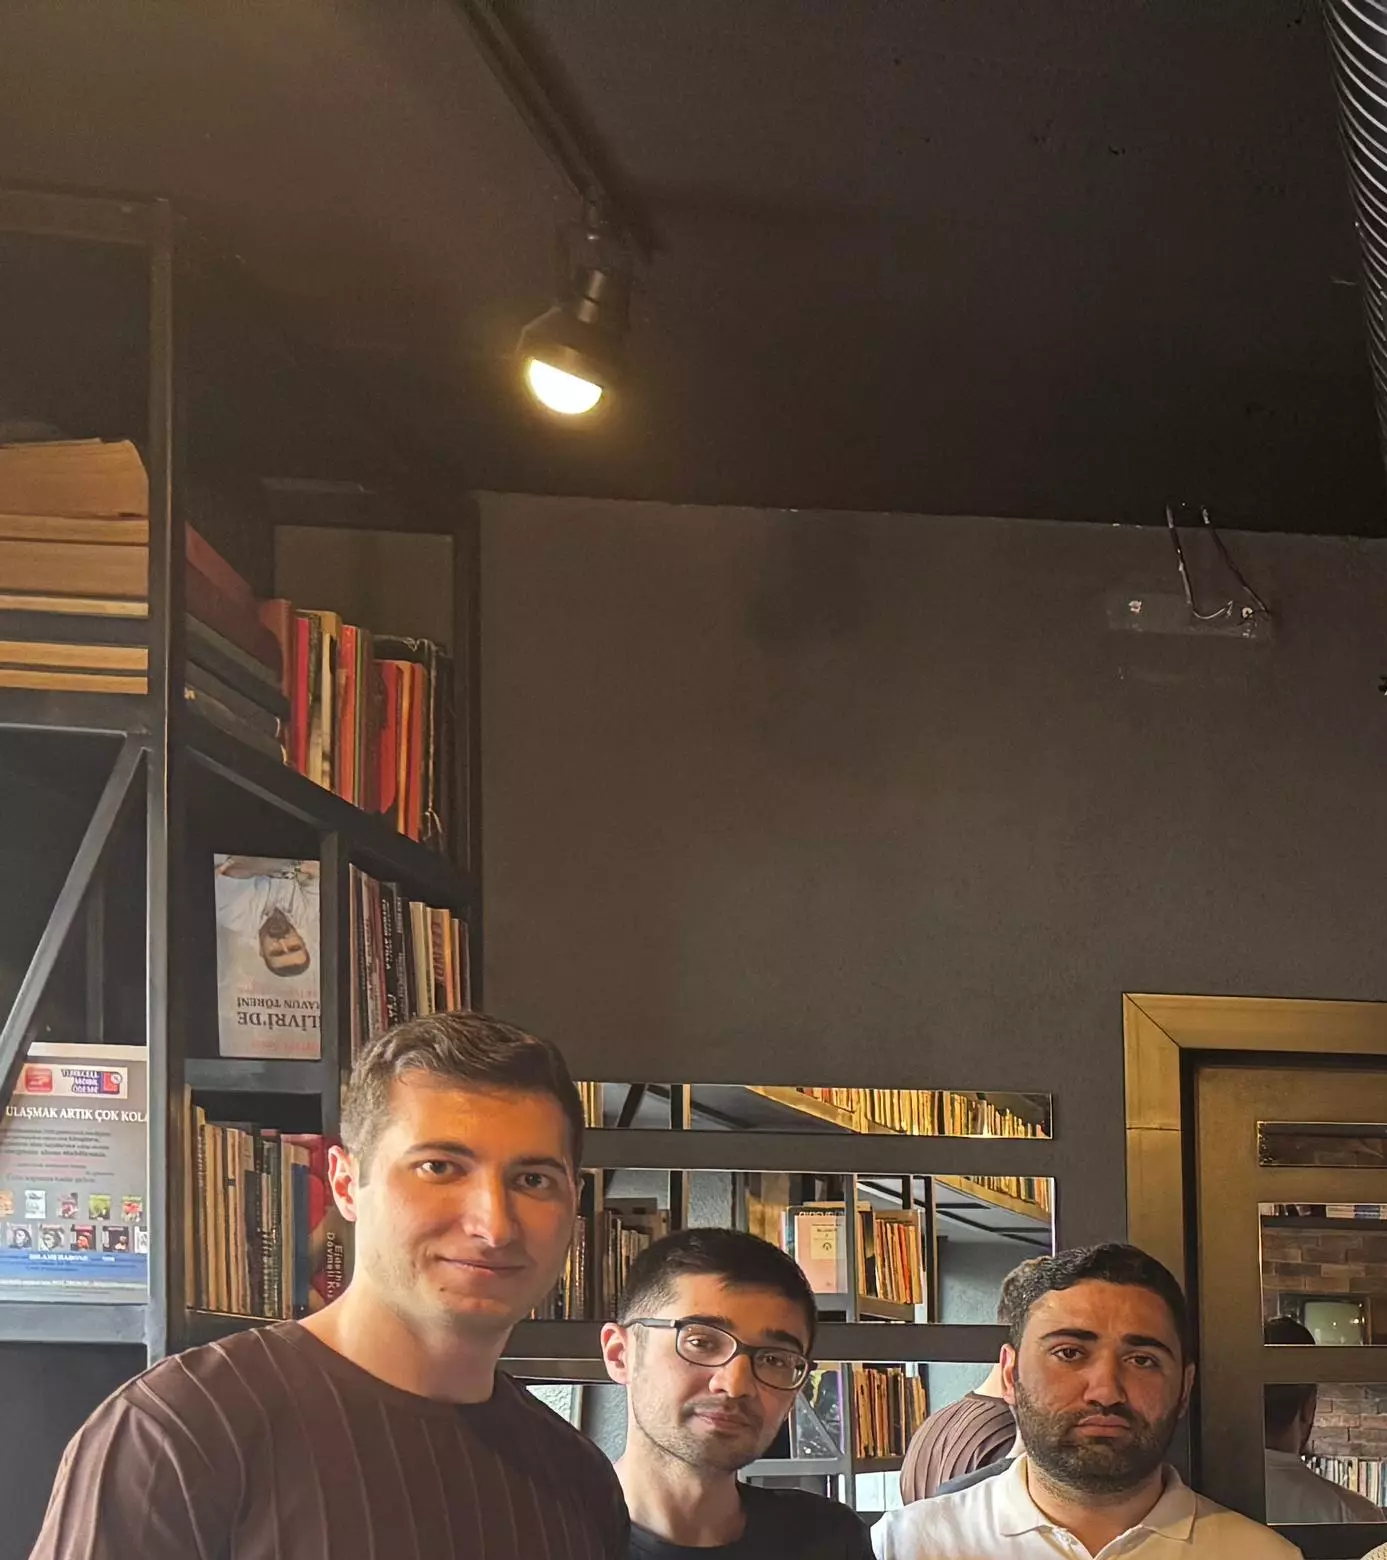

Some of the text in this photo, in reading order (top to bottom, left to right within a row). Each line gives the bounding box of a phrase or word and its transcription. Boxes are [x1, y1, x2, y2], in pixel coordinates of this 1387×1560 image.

[236, 996, 281, 1009] TÖRENİ
[5, 1105, 58, 1120] ULAŞMAK
[59, 1108, 93, 1120] ARTIK
[95, 1109, 119, 1122] ÇOK
